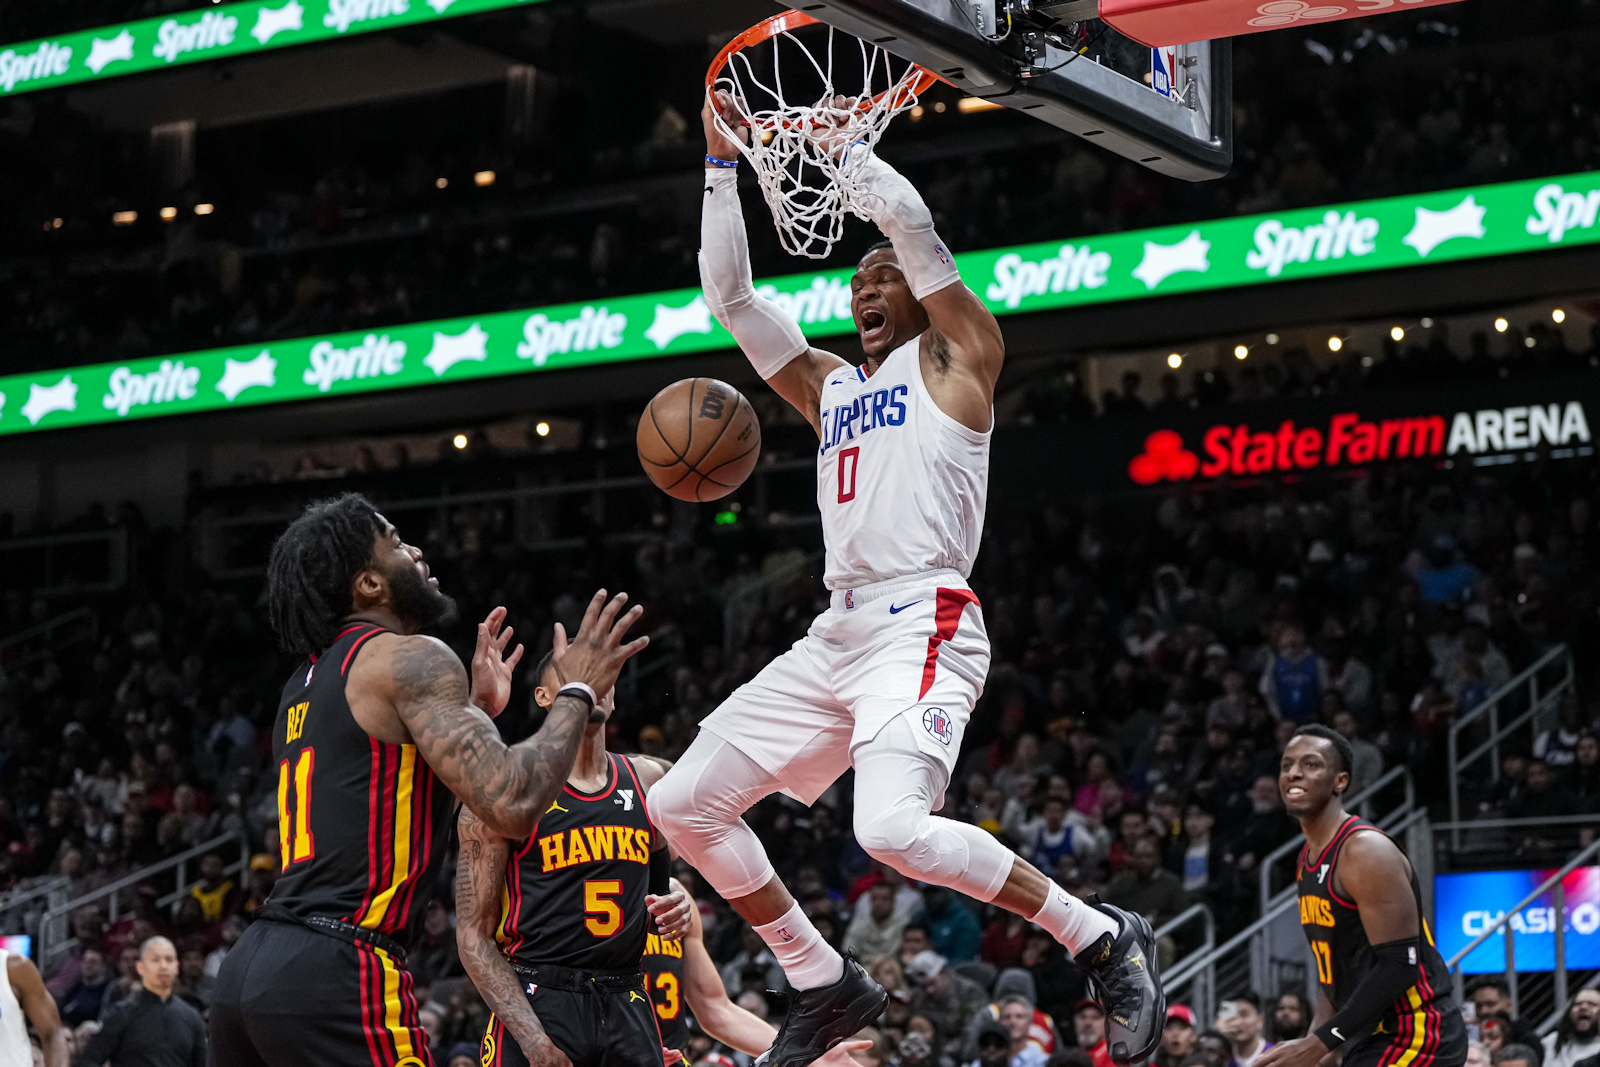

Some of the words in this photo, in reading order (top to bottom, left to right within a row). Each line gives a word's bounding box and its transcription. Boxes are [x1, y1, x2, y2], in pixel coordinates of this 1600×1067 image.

[153, 12, 238, 62] Sprite
[0, 42, 73, 91] Sprite
[1155, 70, 1168, 93] NBA
[1525, 184, 1600, 243] Spr
[1246, 210, 1380, 277] Sprite
[987, 245, 1111, 309] Sprite
[303, 334, 407, 391] Sprite
[516, 306, 627, 366] Sprite
[103, 360, 200, 416] Sprite
[1200, 421, 1322, 477] State
[1326, 413, 1445, 465] Farm
[1447, 401, 1590, 454] ARENA
[838, 446, 859, 504] 0
[286, 701, 310, 745] BEY
[538, 825, 650, 873] HAWKS
[584, 879, 624, 937] 5
[1298, 894, 1336, 928] AWKS
[643, 931, 683, 959] WKS
[1311, 940, 1333, 986] 17
